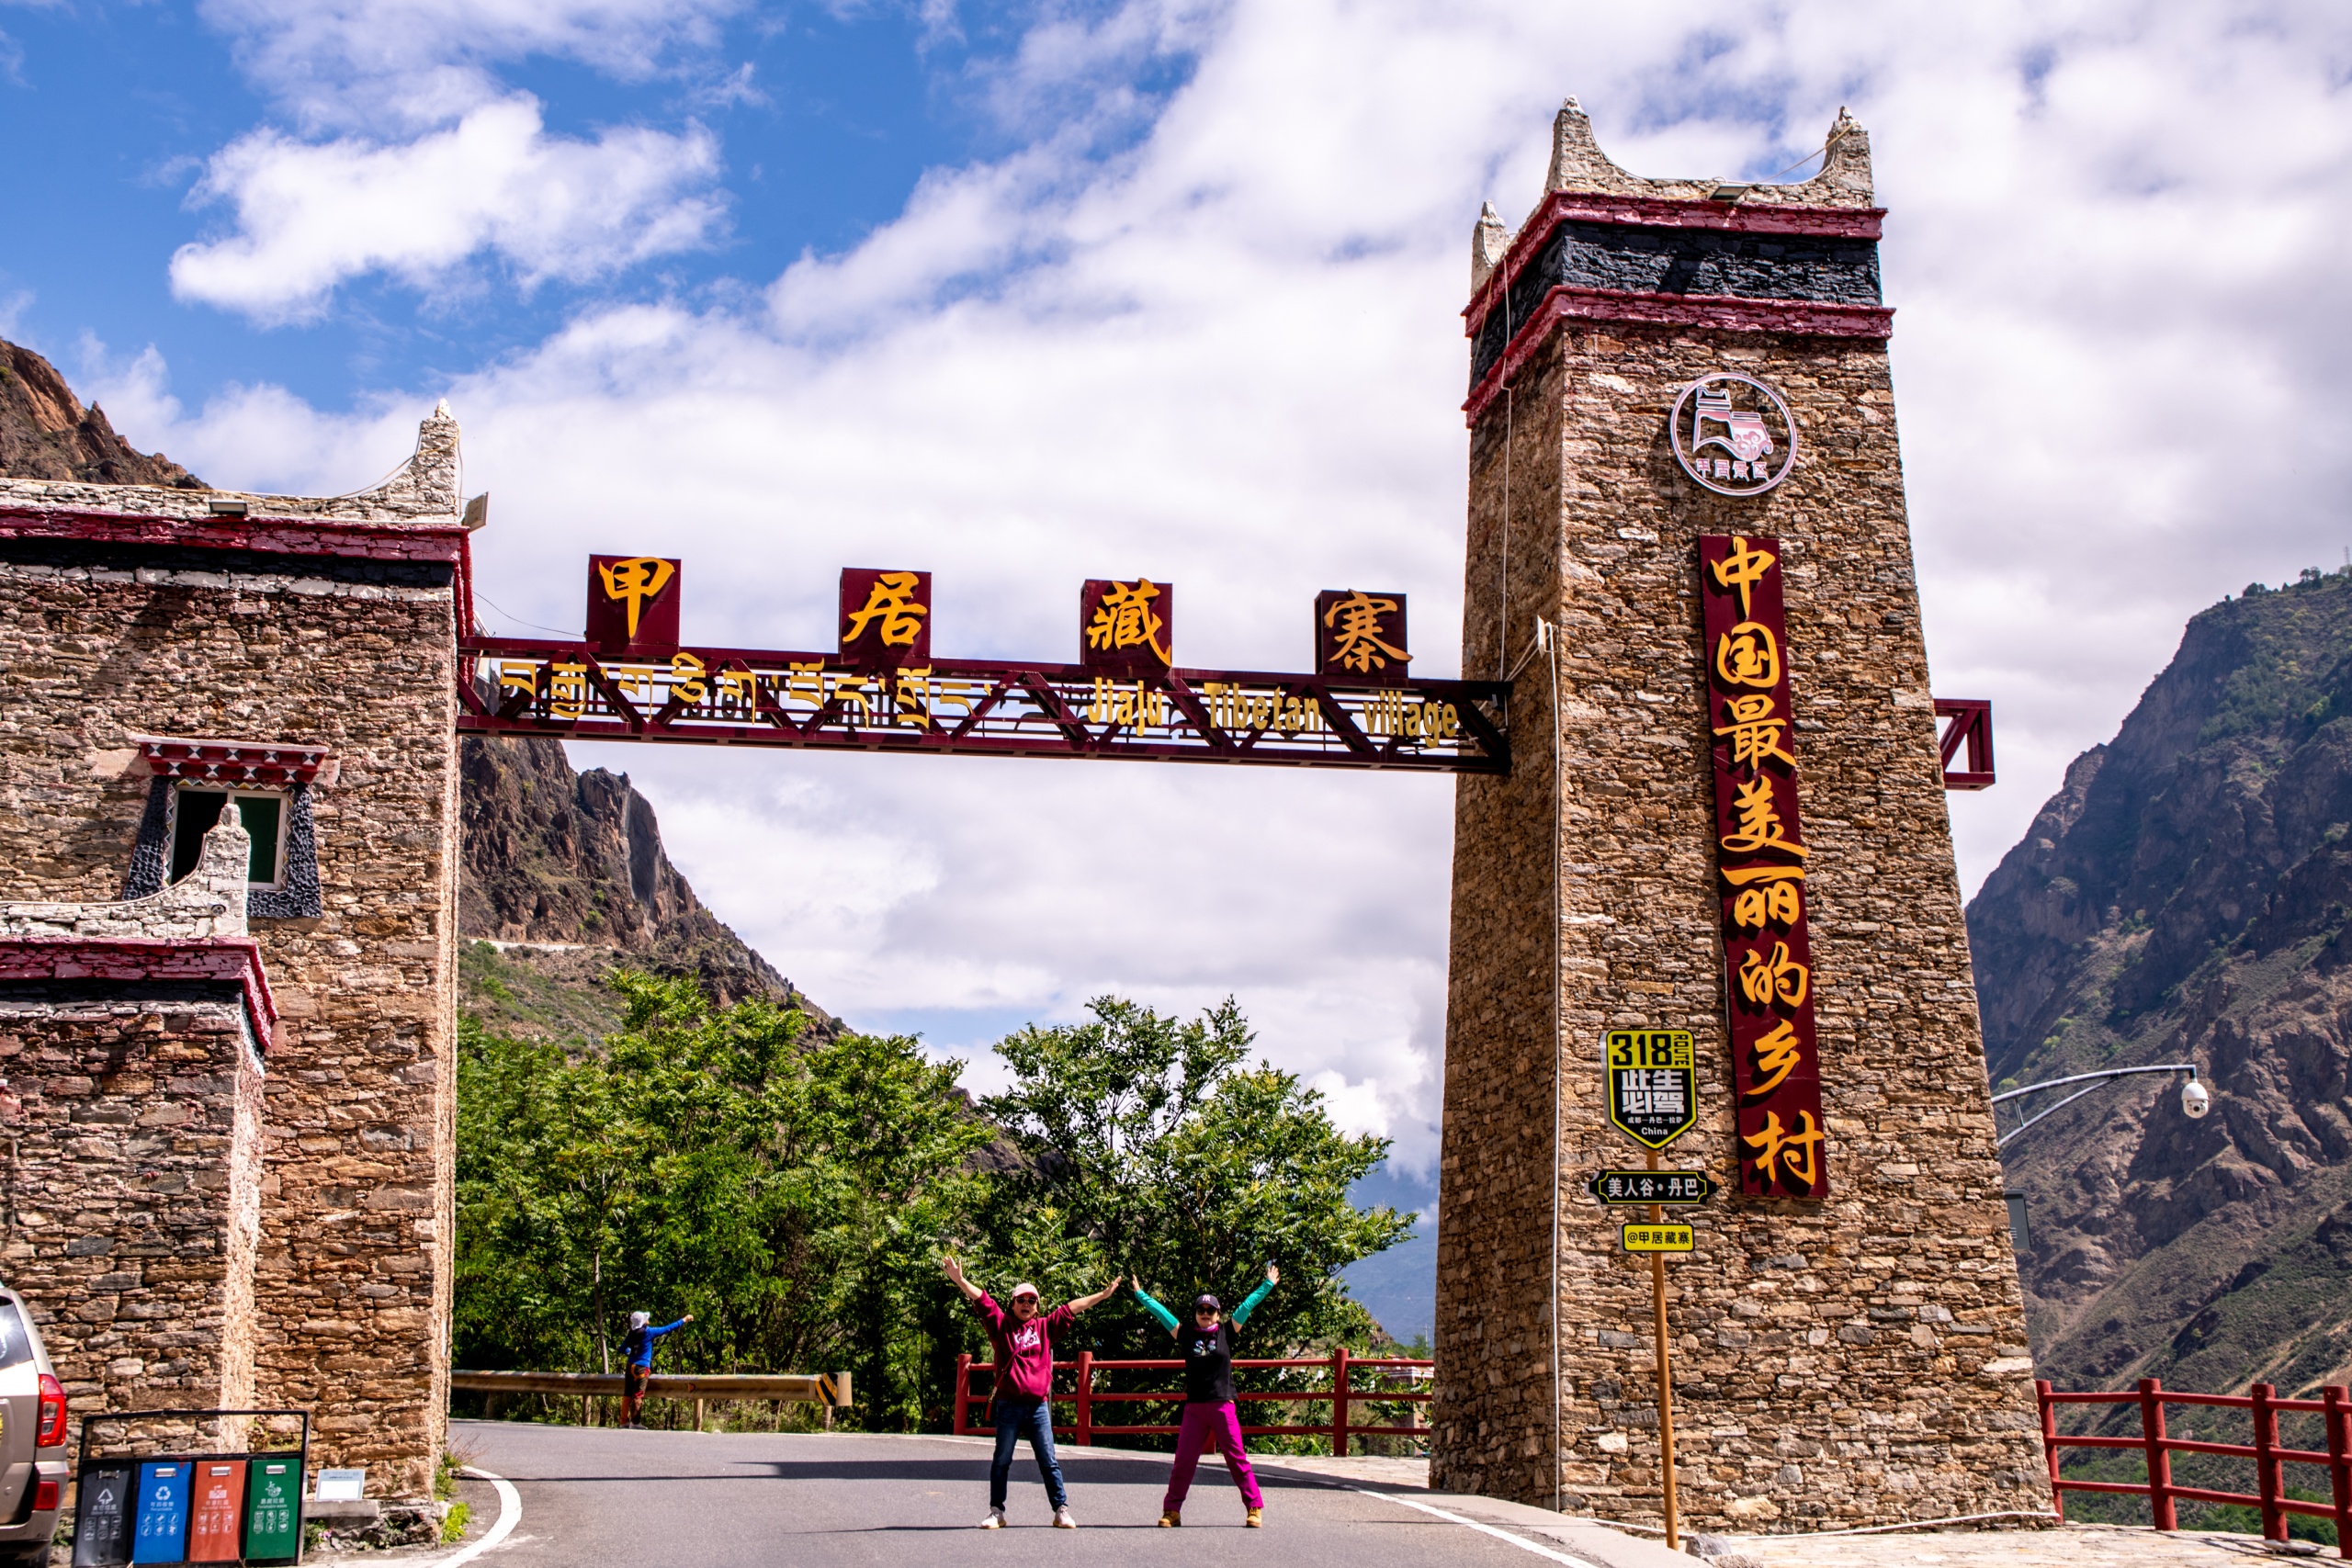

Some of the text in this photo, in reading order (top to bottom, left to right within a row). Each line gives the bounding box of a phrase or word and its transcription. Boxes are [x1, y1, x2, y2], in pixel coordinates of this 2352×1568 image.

[1696, 458, 1769, 482] 甲居景区
[599, 557, 1412, 673] 甲居藏寨
[1087, 677, 1459, 749] Jiaju Tibetan village
[1711, 536, 1826, 1187] 中国最美丽的乡村
[1611, 1033, 1672, 1066] 318
[1673, 1034, 1690, 1066] ROUTE
[1622, 1069, 1683, 1091] 此生
[1622, 1091, 1685, 1114] 必驾
[1641, 1126, 1668, 1135] China
[1627, 1231, 1690, 1246] @甲居藏寨
